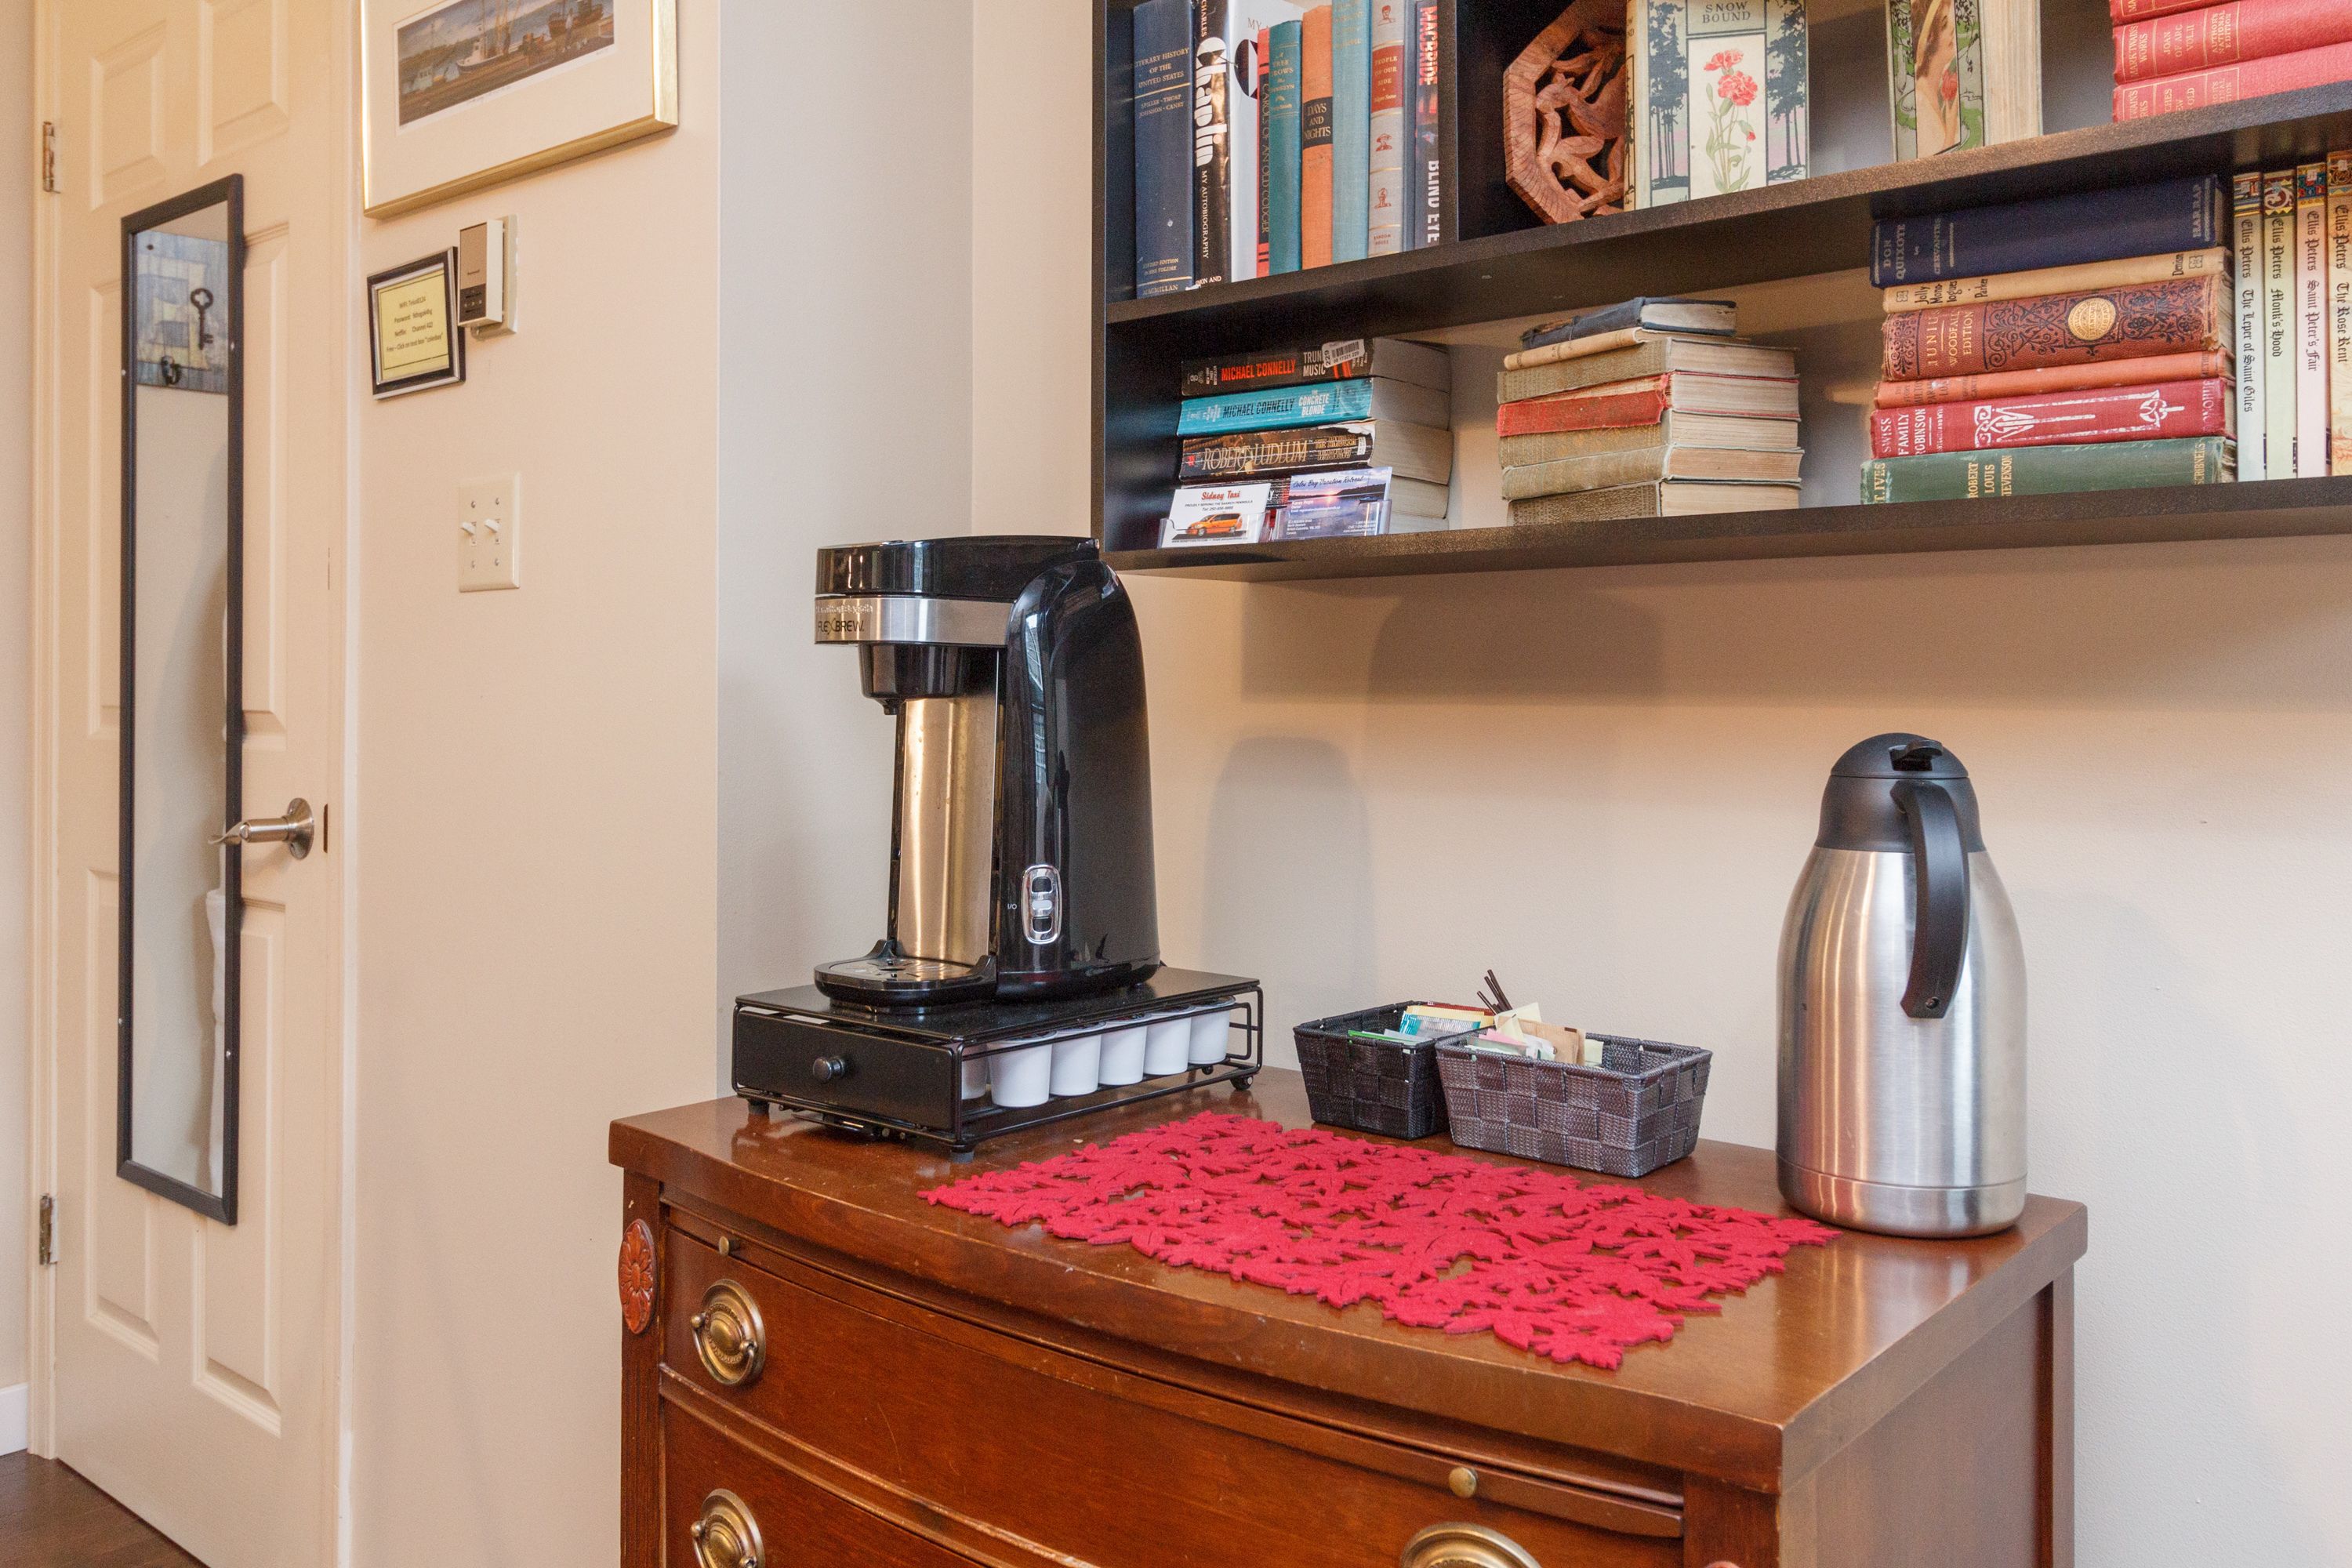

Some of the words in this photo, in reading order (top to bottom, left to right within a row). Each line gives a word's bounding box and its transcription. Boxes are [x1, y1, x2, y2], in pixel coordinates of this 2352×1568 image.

[1702, 11, 1751, 24] BOUND
[1705, 1, 1748, 13] SNOW
[1248, 17, 1261, 30] MY
[1162, 47, 1189, 60] HISTORY
[1419, 5, 1439, 85] MACBRIDE
[2139, 33, 2148, 63] WORKS
[2176, 44, 2183, 57] OF
[1160, 63, 1171, 71] THE
[1375, 56, 1398, 65] PEOPLE
[2128, 52, 2138, 77] MARK
[1138, 77, 1160, 88] UNITED
[1162, 71, 1185, 81] STATES
[1377, 78, 1392, 87] SIDE
[1195, 37, 1227, 167] Chaplin
[2187, 87, 2195, 106] OLD
[1307, 103, 1327, 116] DAYS
[1309, 116, 1324, 125] AND
[1305, 125, 1331, 141] NIGHTS
[1201, 170, 1207, 184] MY
[1428, 160, 1440, 208] BLIND
[2193, 183, 2202, 238] HARRAP
[2307, 210, 2320, 235] Ellis
[2335, 205, 2350, 232] Ellis
[1427, 213, 1440, 243] EYE
[2241, 219, 2253, 244] Ellis
[2271, 218, 2284, 244] Ellis
[1883, 239, 1892, 268] DON
[1896, 224, 1906, 280] QUIXOTE
[2240, 245, 2253, 279] Peters
[2270, 245, 2283, 279] Peters
[2305, 237, 2320, 271] Peters
[2333, 234, 2350, 270] Peters
[2172, 253, 2184, 277] Denison
[1143, 285, 1178, 295] MACMILLAN
[1915, 285, 1931, 305] Jolly
[1929, 283, 1944, 304] Mono-
[1947, 281, 1962, 303] logues
[1974, 278, 1989, 299] Parker
[2242, 289, 2254, 309] The
[2307, 280, 2320, 309] Saint
[2336, 282, 2350, 303] The
[2270, 288, 2284, 328] Monk's
[1962, 310, 1974, 356] EDITION
[2243, 311, 2255, 339] Leper
[2305, 312, 2320, 351] Peter's
[2336, 305, 2350, 337] Rose
[1948, 310, 1961, 366] WOODFALL
[2245, 343, 2255, 353] of
[2271, 329, 2284, 358] Hood
[2337, 336, 2350, 363] Rent
[1303, 350, 1323, 364] TRUN
[2243, 355, 2256, 383] Saint
[2306, 349, 2321, 372] Fair
[1221, 363, 1255, 382] MICHAEL
[1256, 358, 1296, 378] CONNELLY
[1303, 364, 1326, 376] MUSIC
[1223, 403, 1255, 419] MICHAEL
[1256, 397, 1295, 415] CONNELLY
[1298, 394, 1330, 406] CONCRETE
[1301, 404, 1326, 416] BLONDE
[2243, 386, 2255, 412] Giles
[1881, 417, 1893, 453] SWISS
[1897, 413, 1909, 456] FAMILY
[1202, 445, 1251, 472] ROBERT
[1254, 439, 1308, 466] LUDLUM
[1308, 479, 1319, 488] Bay
[1319, 477, 1342, 486] Vacation
[1342, 475, 1363, 484] Retreat
[1874, 463, 1886, 490] IVES
[1968, 462, 1979, 499] ROBERT
[1984, 464, 1995, 494] LOUIS
[2001, 456, 2013, 497] TEVENSON
[1201, 492, 1225, 501] Sidney
[1227, 490, 1241, 499] Taxi
